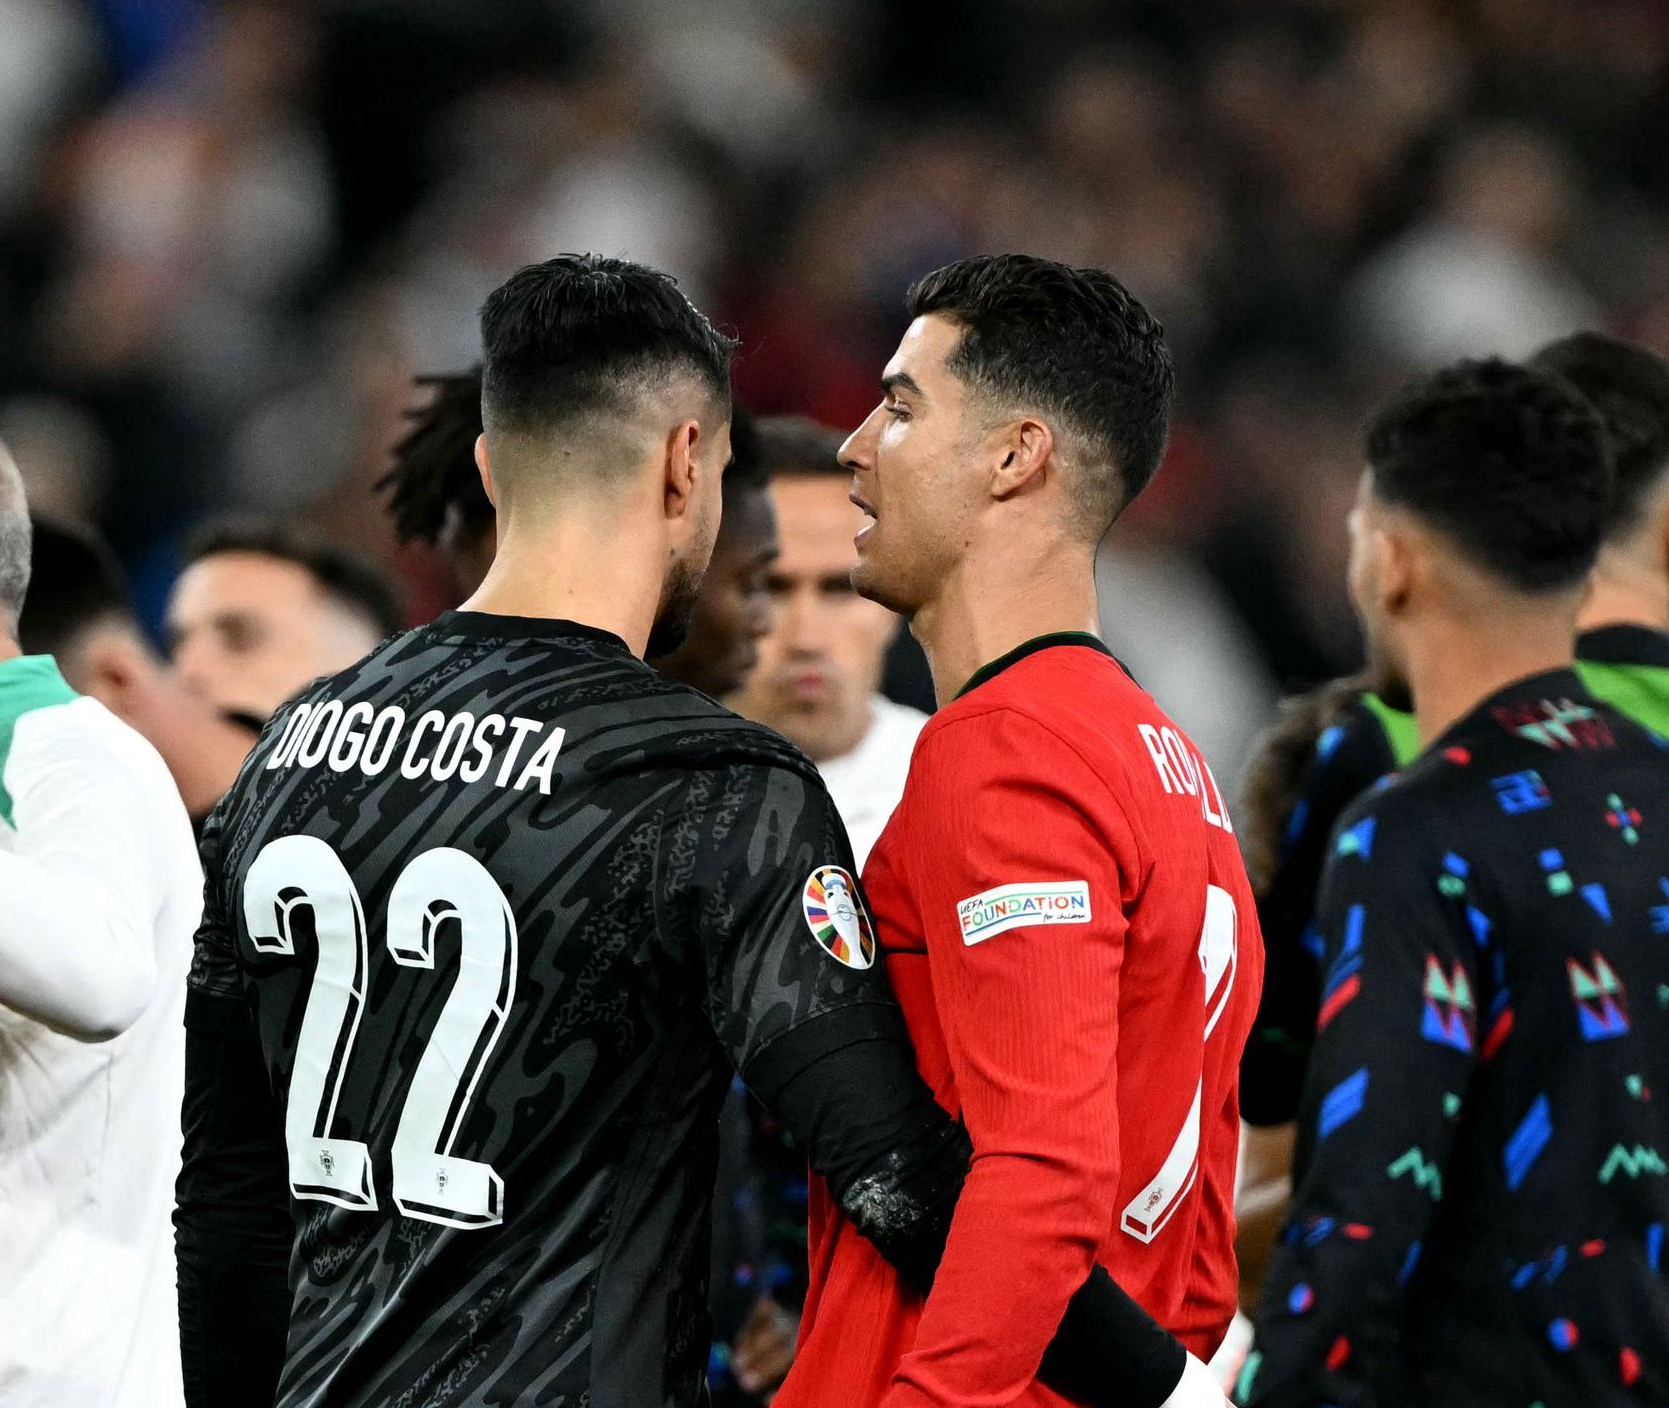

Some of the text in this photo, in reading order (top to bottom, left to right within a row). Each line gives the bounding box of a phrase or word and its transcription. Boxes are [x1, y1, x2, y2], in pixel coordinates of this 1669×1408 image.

[266, 699, 566, 795] DIOGO COSTA
[960, 899, 984, 915] UEFA
[243, 834, 519, 1230] 22
